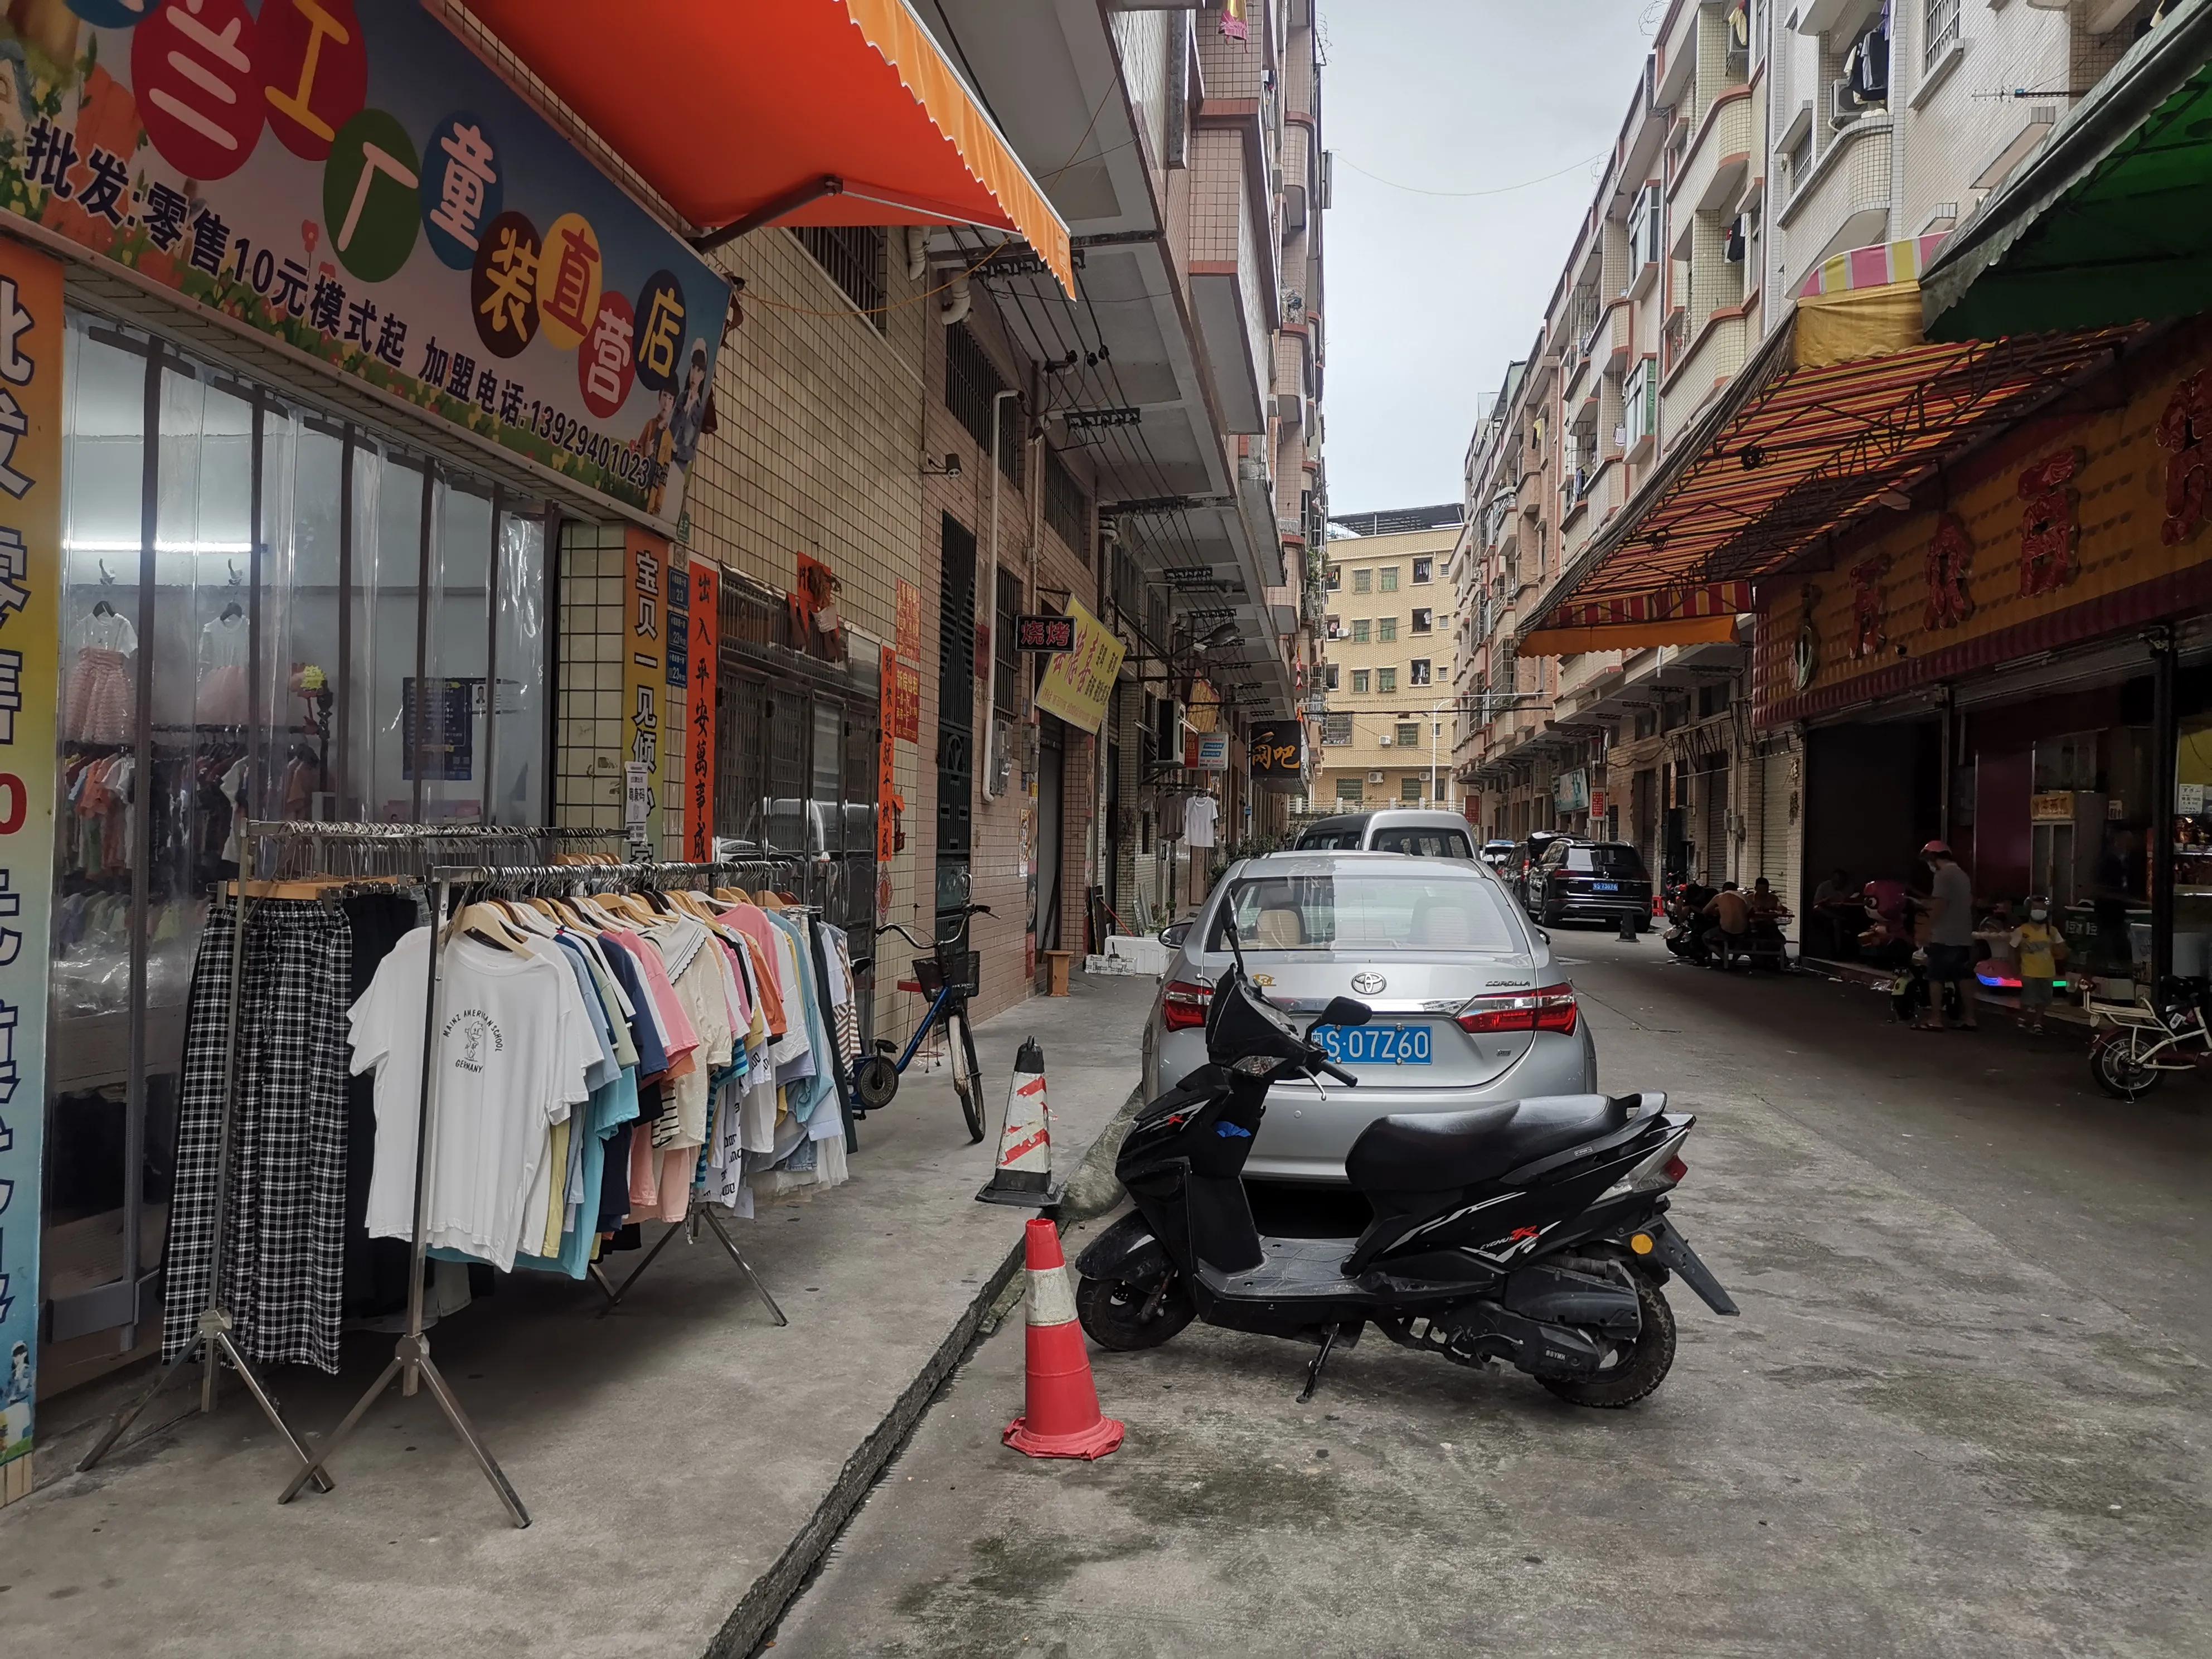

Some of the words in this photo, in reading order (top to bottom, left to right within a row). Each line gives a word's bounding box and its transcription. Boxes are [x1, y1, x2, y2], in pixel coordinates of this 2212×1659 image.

[1021, 620, 1070, 646] 烧烤
[630, 550, 659, 865] 宝贝一见倾
[443, 1014, 461, 1037] MAINZ
[463, 1009, 494, 1027] AMERICAN
[491, 1025, 503, 1052] SCHOOL
[455, 1059, 483, 1073] GERMANY
